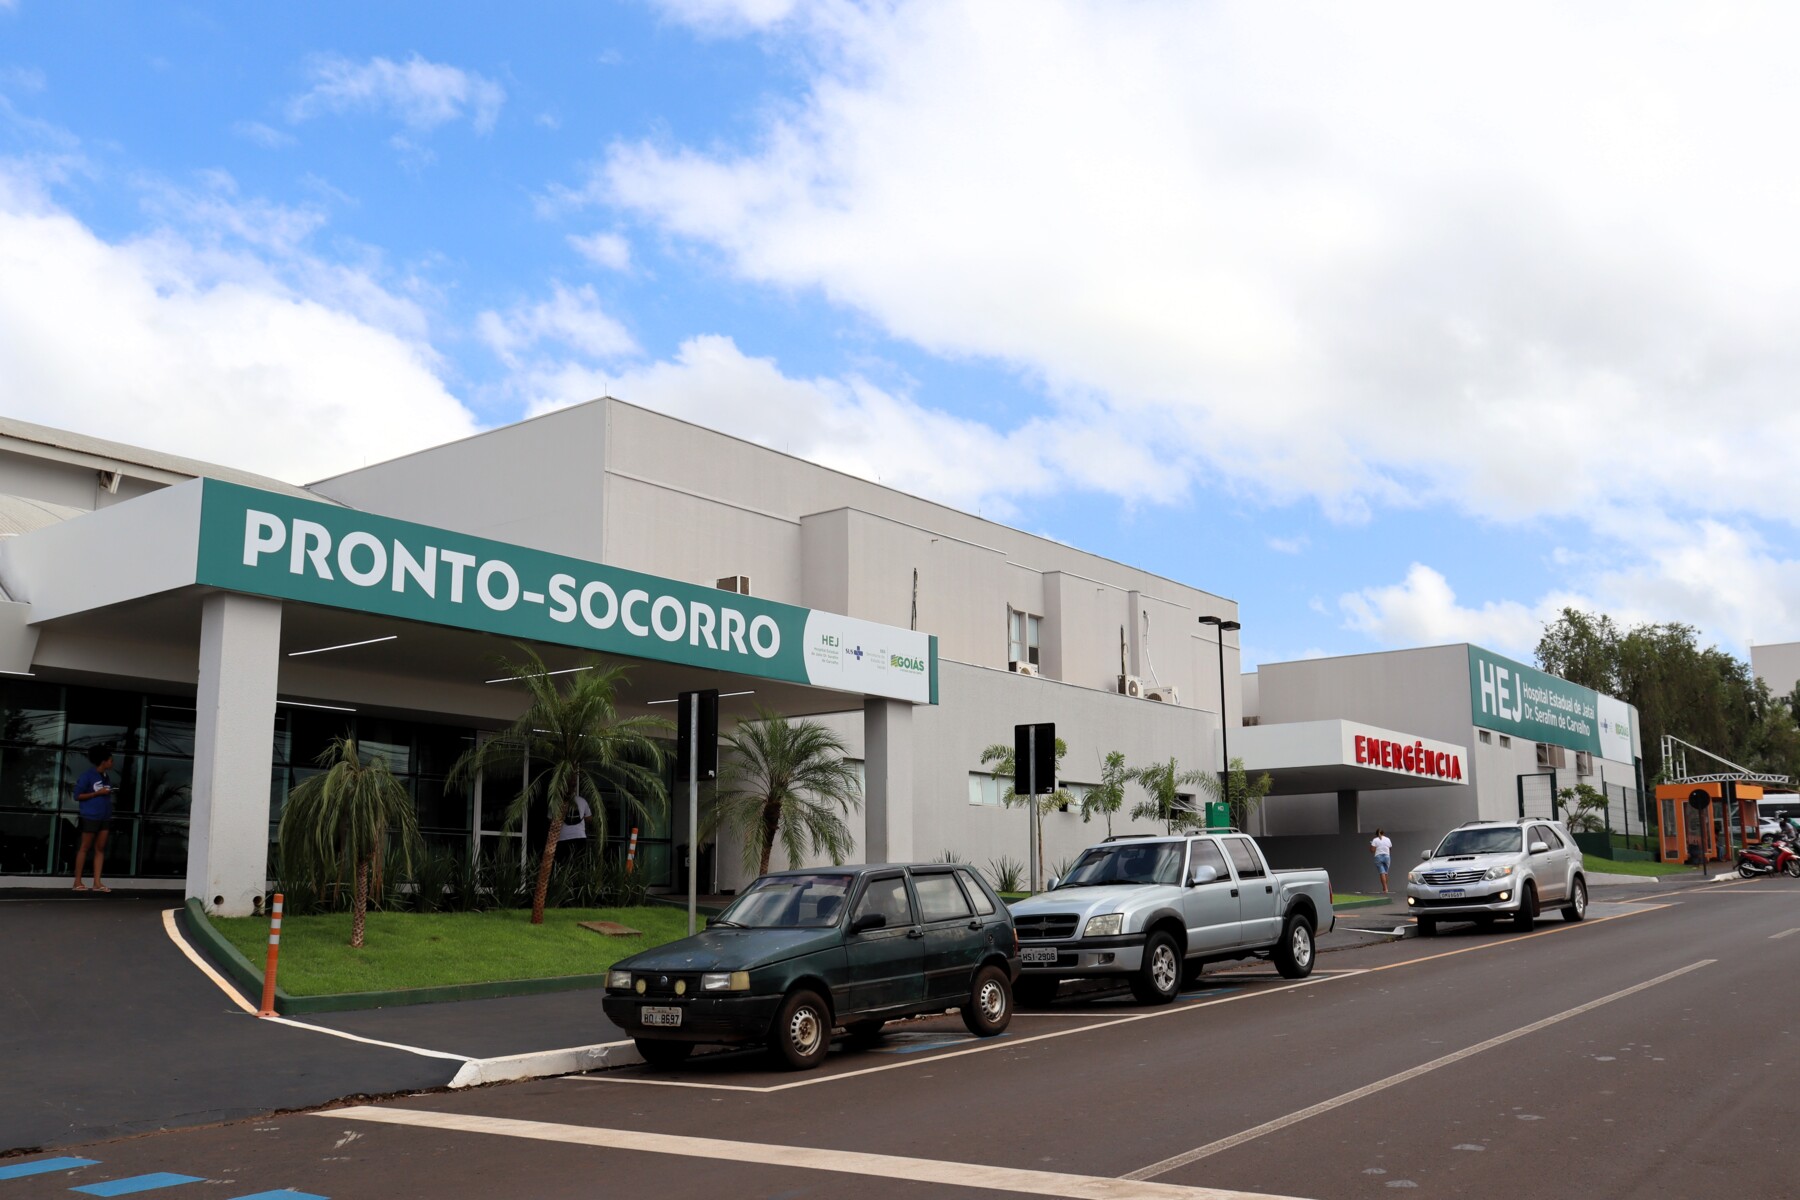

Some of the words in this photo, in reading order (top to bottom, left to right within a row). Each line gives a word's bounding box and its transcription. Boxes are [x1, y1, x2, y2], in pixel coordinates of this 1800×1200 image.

[243, 509, 780, 658] PRONTO-SOCORRO
[822, 635, 839, 647] HEJ
[897, 657, 924, 672] GOIÁS
[1479, 659, 1522, 723] HEJ
[1523, 681, 1548, 705] Hospital
[1549, 690, 1573, 712] Estadual
[1574, 699, 1581, 714] de
[1525, 703, 1534, 720] Dr.
[1535, 706, 1557, 727] Serafim
[1558, 712, 1566, 729] de
[1567, 716, 1590, 737] Carvalho
[1355, 735, 1462, 780] EMERGÊNCIA
